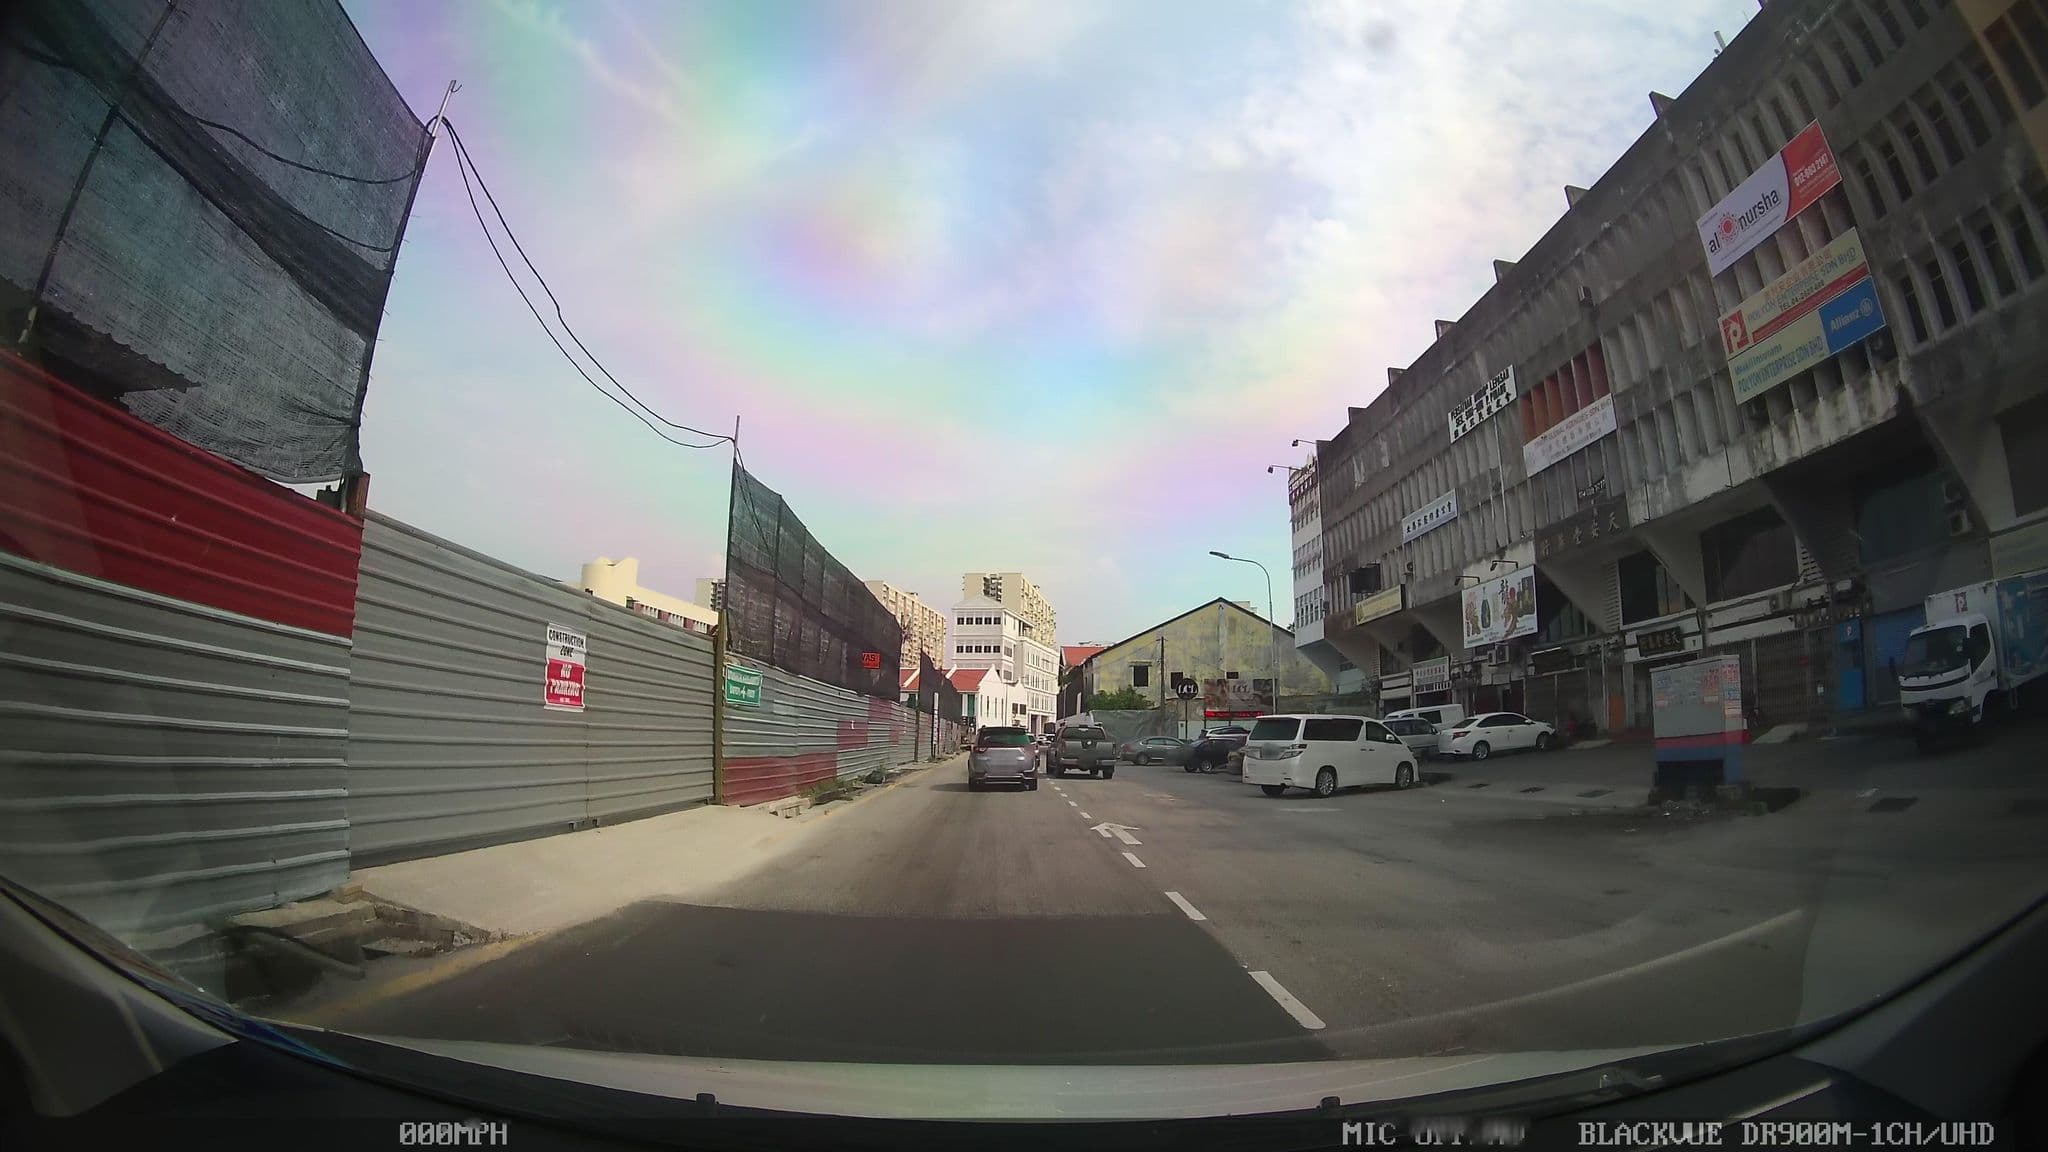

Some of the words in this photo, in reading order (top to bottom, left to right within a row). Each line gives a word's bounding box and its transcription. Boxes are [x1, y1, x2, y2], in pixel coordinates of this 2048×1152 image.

[1708, 231, 1721, 253] al
[1738, 188, 1780, 230] nursha
[1830, 309, 1861, 332] Allianz
[548, 629, 585, 649] CONSTRUCTION
[559, 645, 575, 658] ZONE
[560, 663, 573, 679] NO
[549, 678, 582, 697] PARKING
